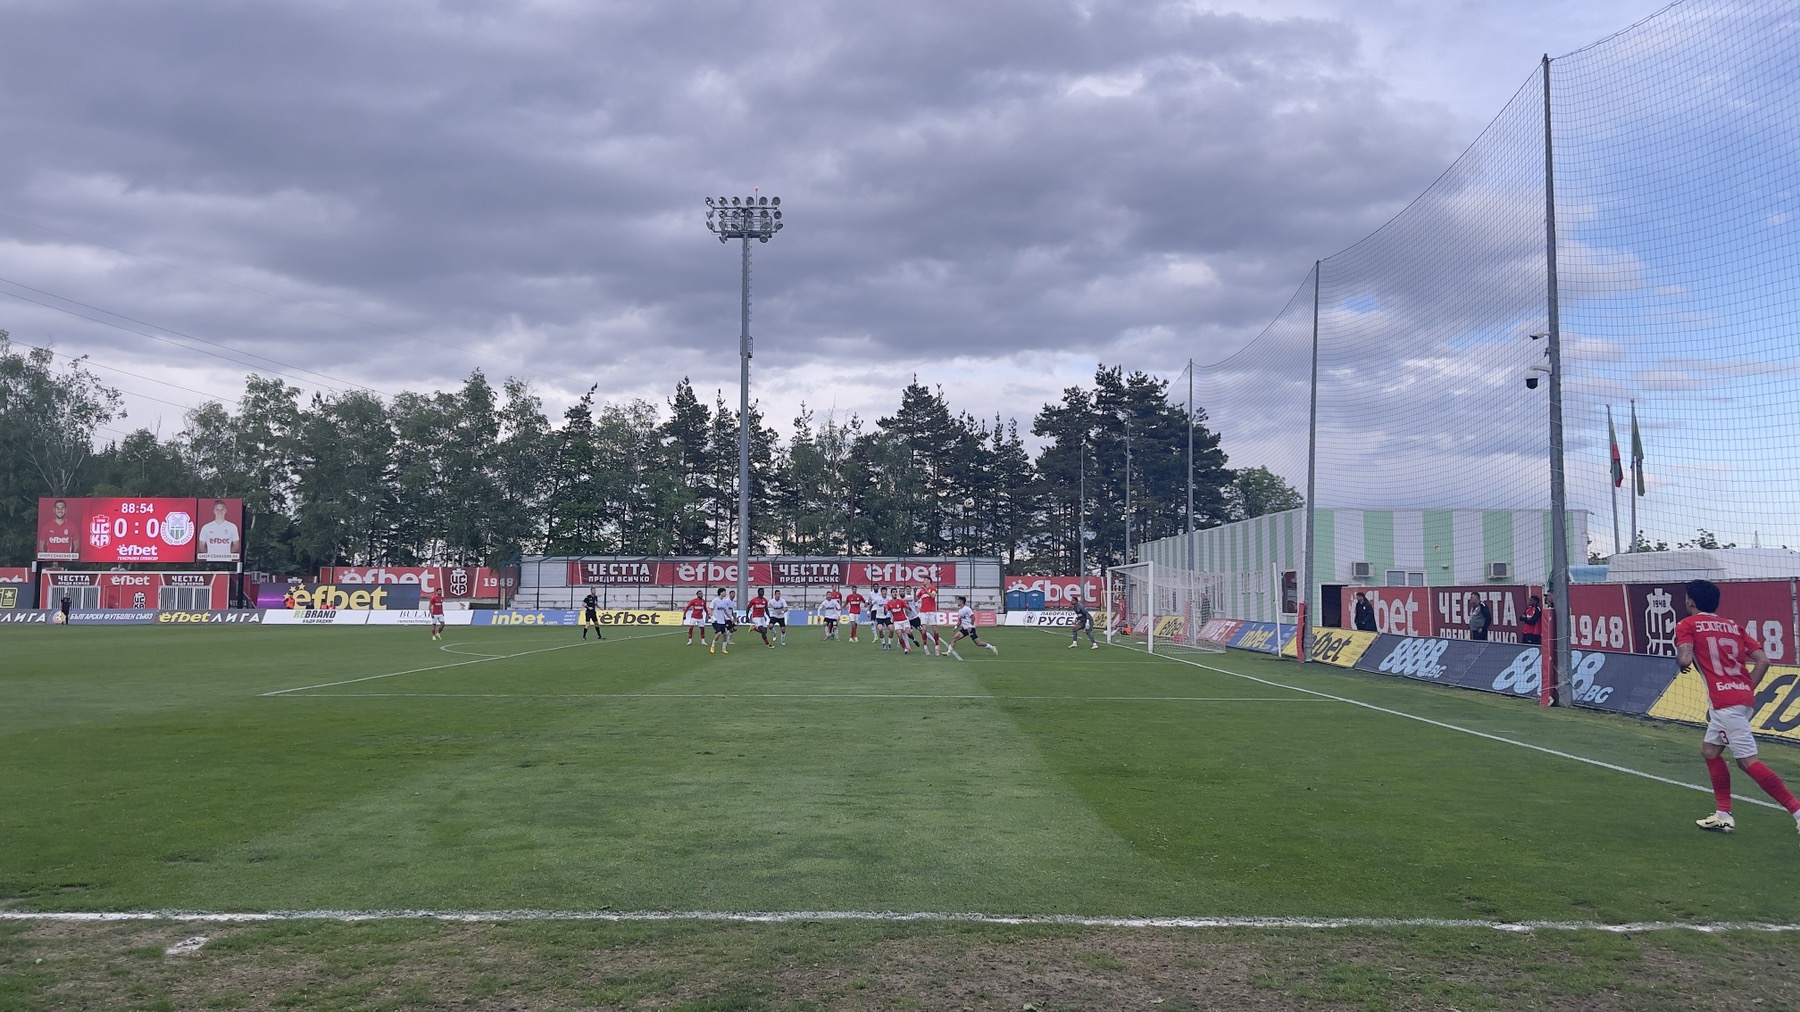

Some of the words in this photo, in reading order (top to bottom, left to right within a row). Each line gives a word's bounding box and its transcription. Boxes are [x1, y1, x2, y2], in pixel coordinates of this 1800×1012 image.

[121, 503, 154, 514] 88:54
[114, 518, 128, 538] 0
[146, 518, 160, 538] 0
[118, 544, 158, 556] efbet
[588, 564, 650, 575] ЧЕСТТА
[779, 564, 840, 576] ЧЕСТТА
[865, 563, 941, 582] efbet
[112, 574, 150, 586] efbet
[484, 578, 514, 586] 1948
[292, 585, 388, 610] efbet
[0, 612, 46, 622] ЛИГА
[159, 612, 211, 623] efbet
[210, 613, 260, 622] ЛИГА
[600, 612, 660, 624] efbet
[1570, 615, 1624, 649] 1948
[1706, 636, 1742, 676] 13
